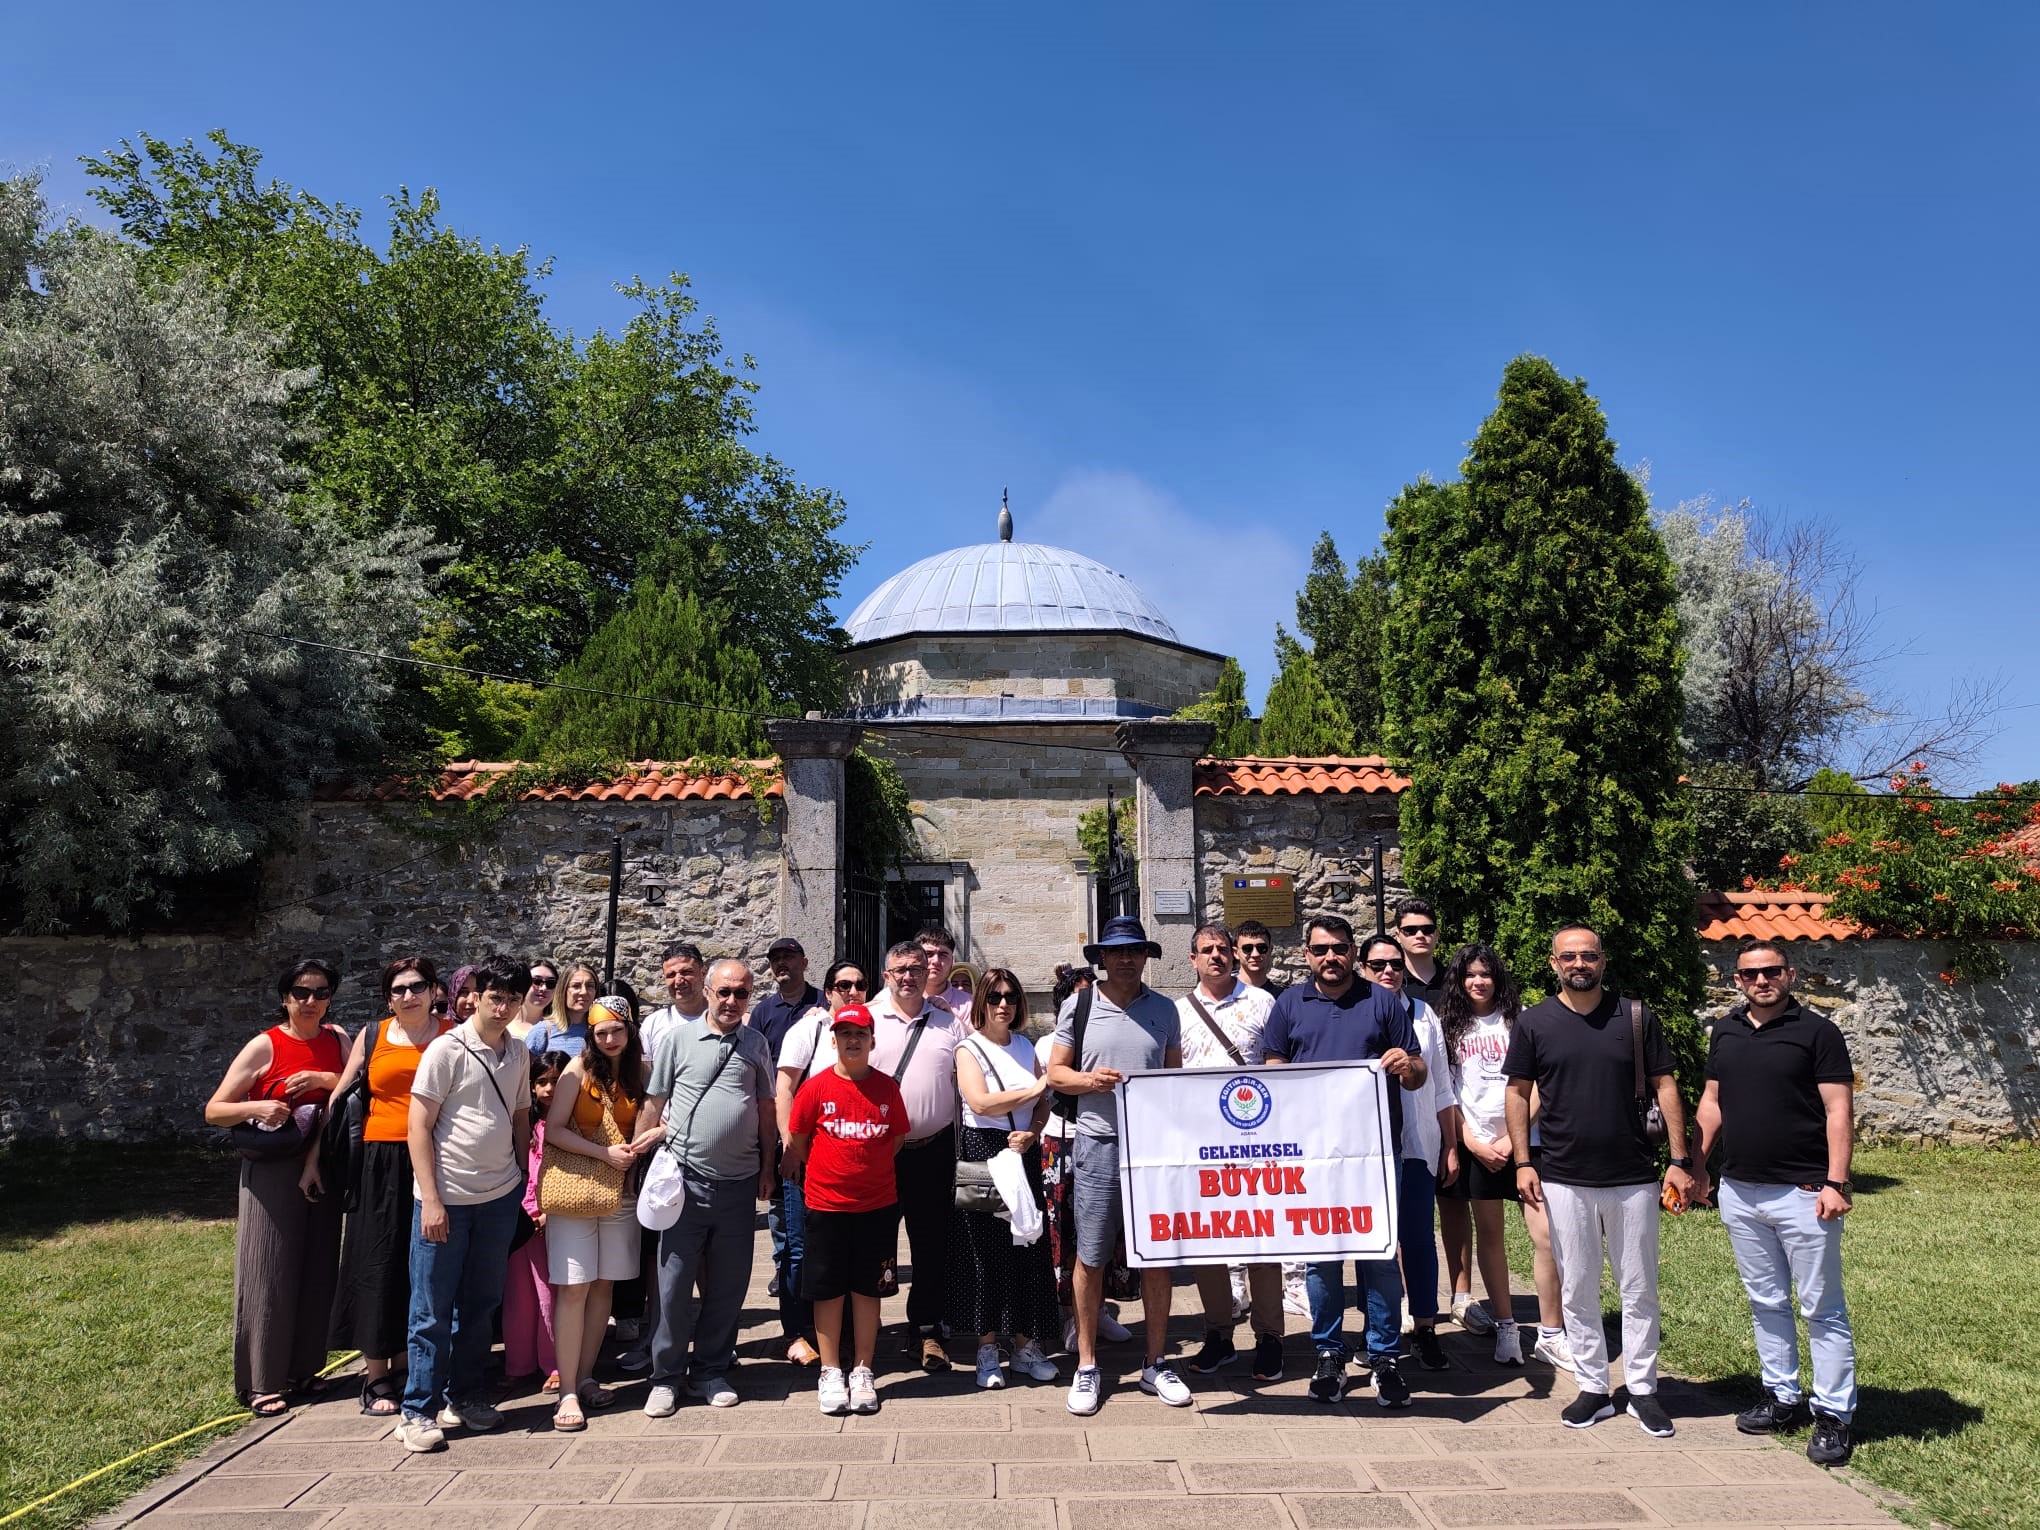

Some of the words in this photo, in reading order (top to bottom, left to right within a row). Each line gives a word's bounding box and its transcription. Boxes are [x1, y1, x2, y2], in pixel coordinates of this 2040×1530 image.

[1199, 1143, 1303, 1160] GELENEKSEL
[1199, 1160, 1307, 1197] BÜYÜK
[1150, 1209, 1275, 1242] BALKAN
[1285, 1206, 1373, 1236] TURU
